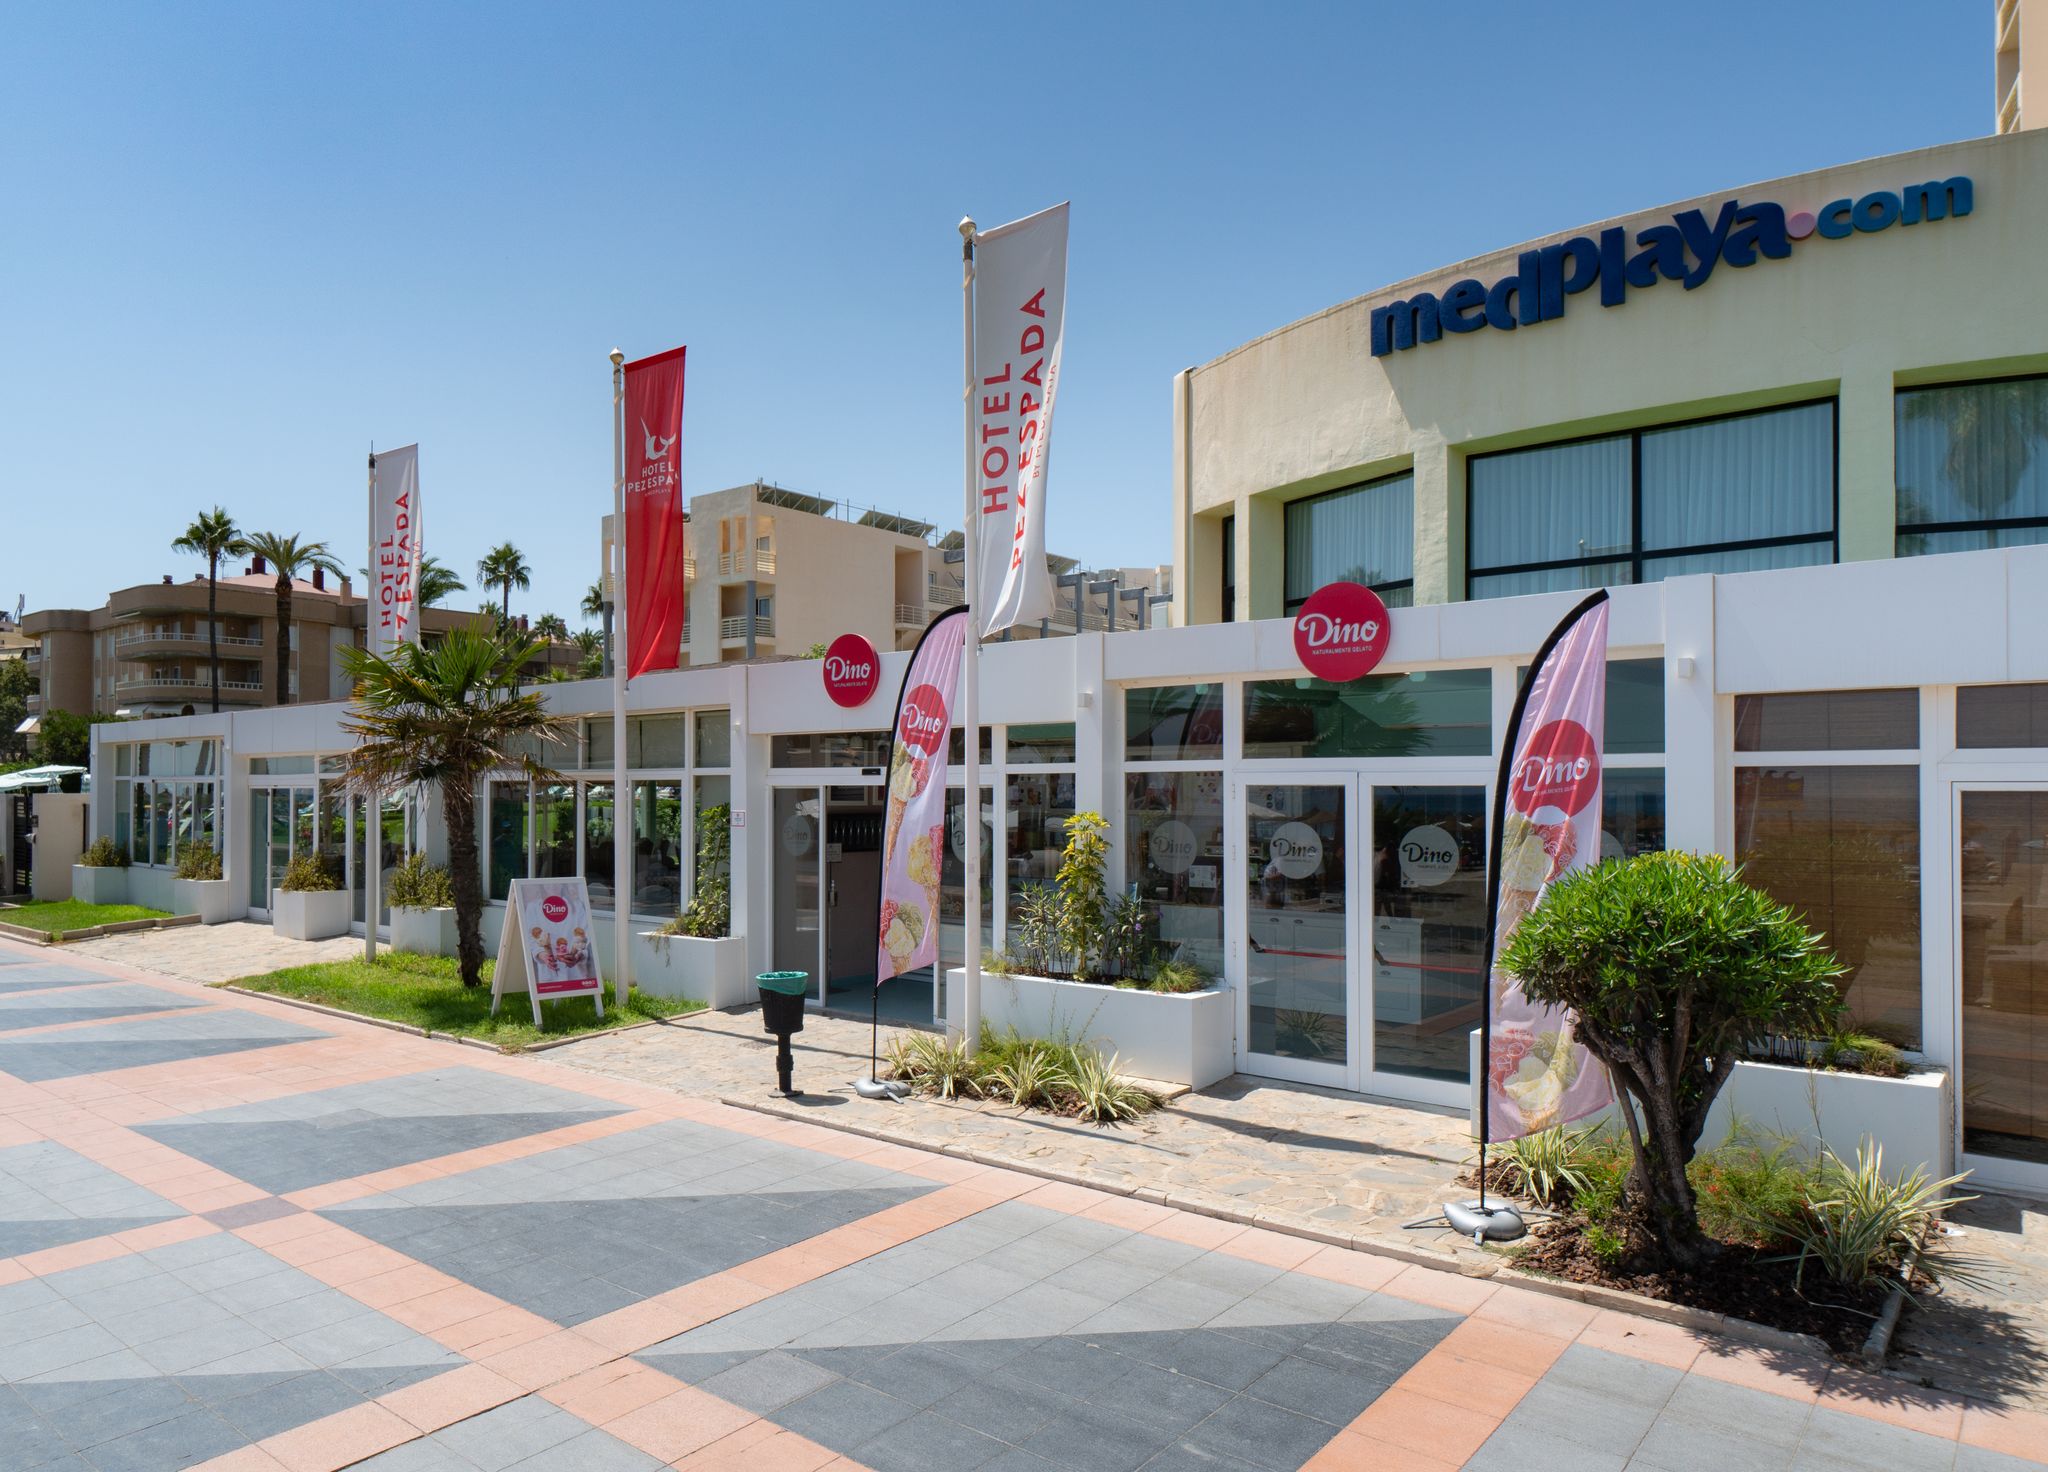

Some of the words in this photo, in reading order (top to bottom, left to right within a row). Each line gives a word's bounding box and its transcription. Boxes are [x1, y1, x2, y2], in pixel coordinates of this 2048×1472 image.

[983, 362, 1011, 515] HOTEL
[641, 461, 675, 478] HOTEL
[380, 534, 395, 627] HOTEL
[1298, 613, 1379, 647] Dino
[825, 656, 871, 682] Dino
[902, 703, 943, 734] Dino
[1517, 755, 1592, 792] Dino
[1153, 836, 1193, 854] Dino
[1272, 837, 1318, 857] Dino
[1402, 842, 1454, 863] Dino
[542, 903, 566, 914] Dino
